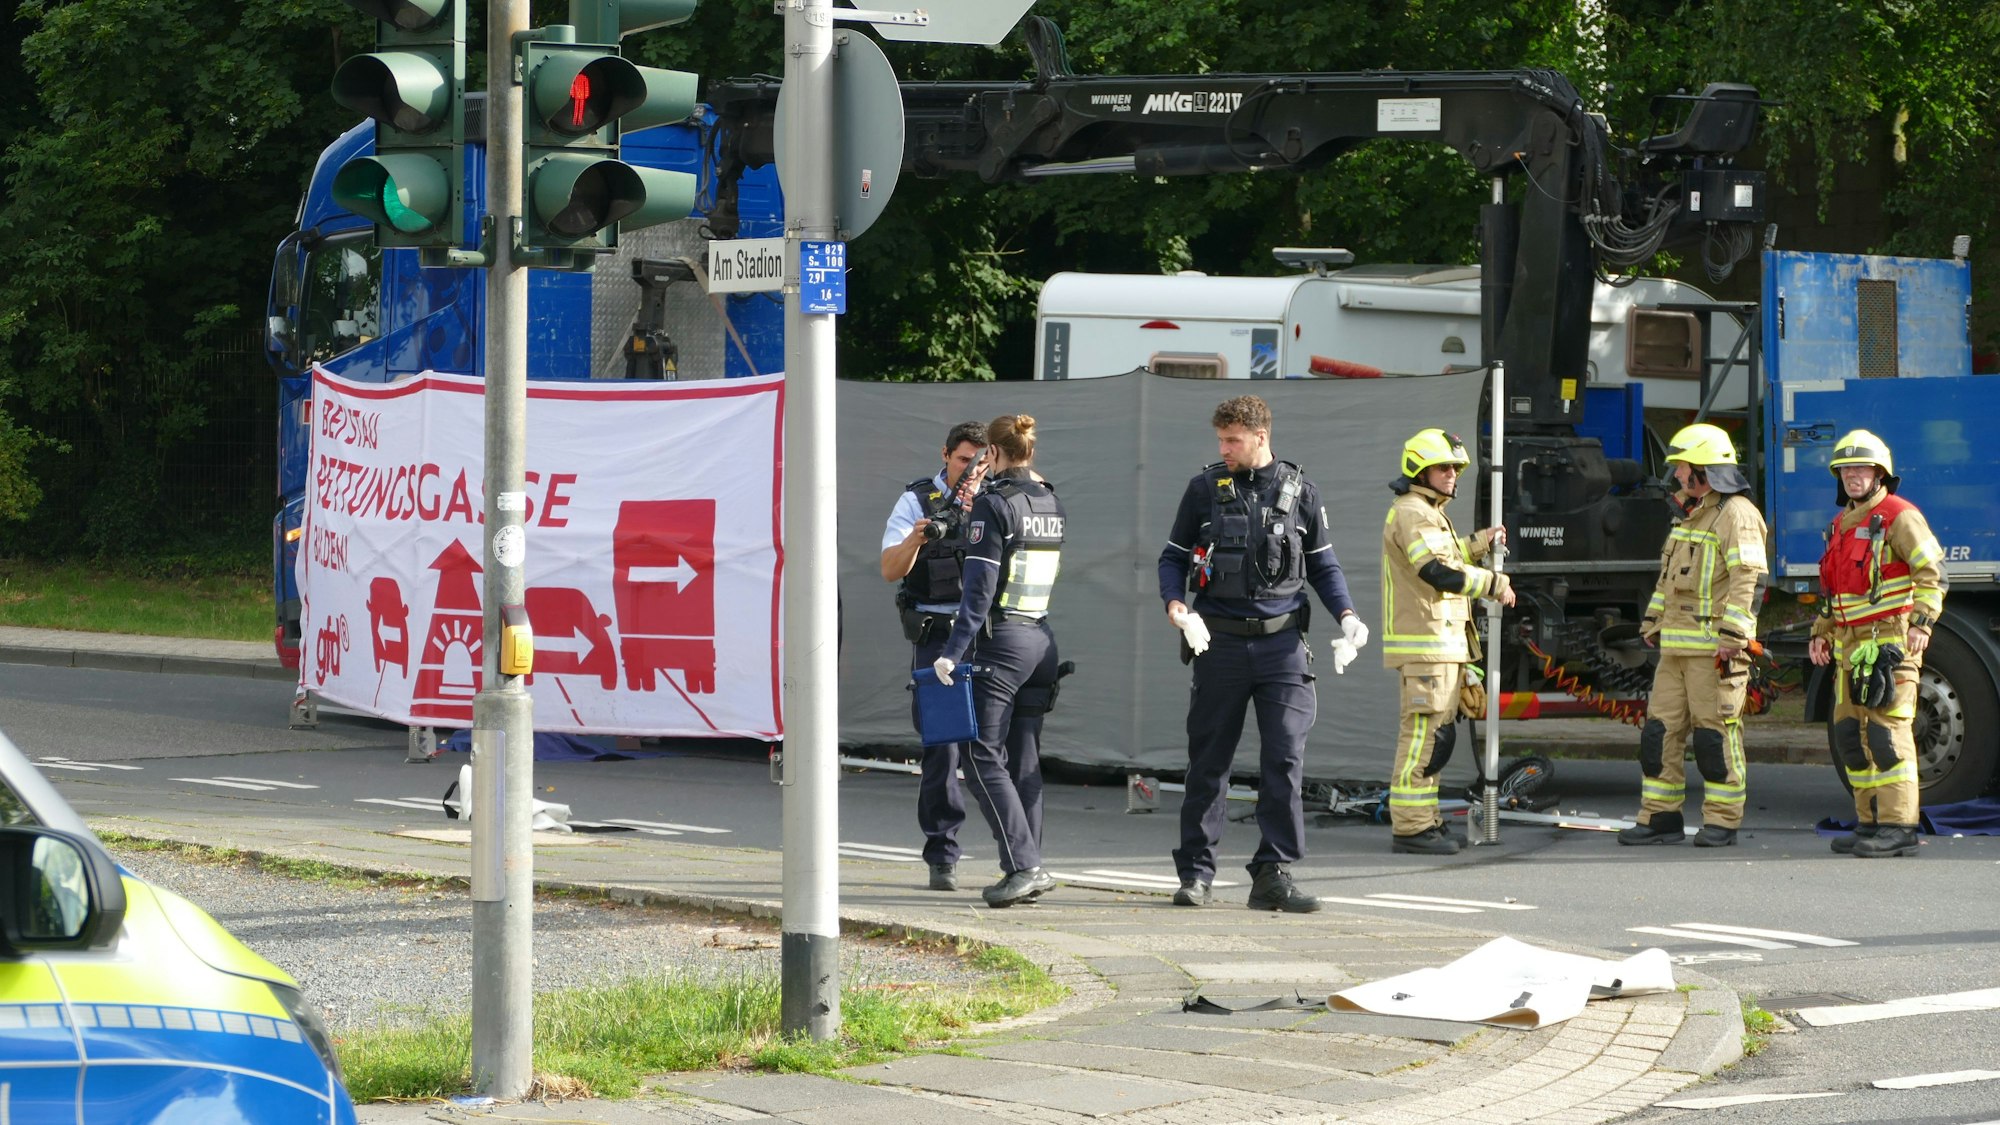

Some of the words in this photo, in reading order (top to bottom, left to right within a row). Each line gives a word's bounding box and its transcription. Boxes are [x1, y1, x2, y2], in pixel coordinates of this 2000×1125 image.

[1091, 94, 1132, 105] WINNEN
[1141, 92, 1193, 114] MKG
[1208, 92, 1243, 113] 221V
[825, 244, 843, 255] 829
[713, 251, 733, 281] Am
[736, 248, 782, 280] Stadion
[826, 256, 843, 267] 100
[316, 453, 578, 528] RETTUNGSGAE
[1520, 527, 1565, 538] WINNEN
[1543, 537, 1564, 546] Polch
